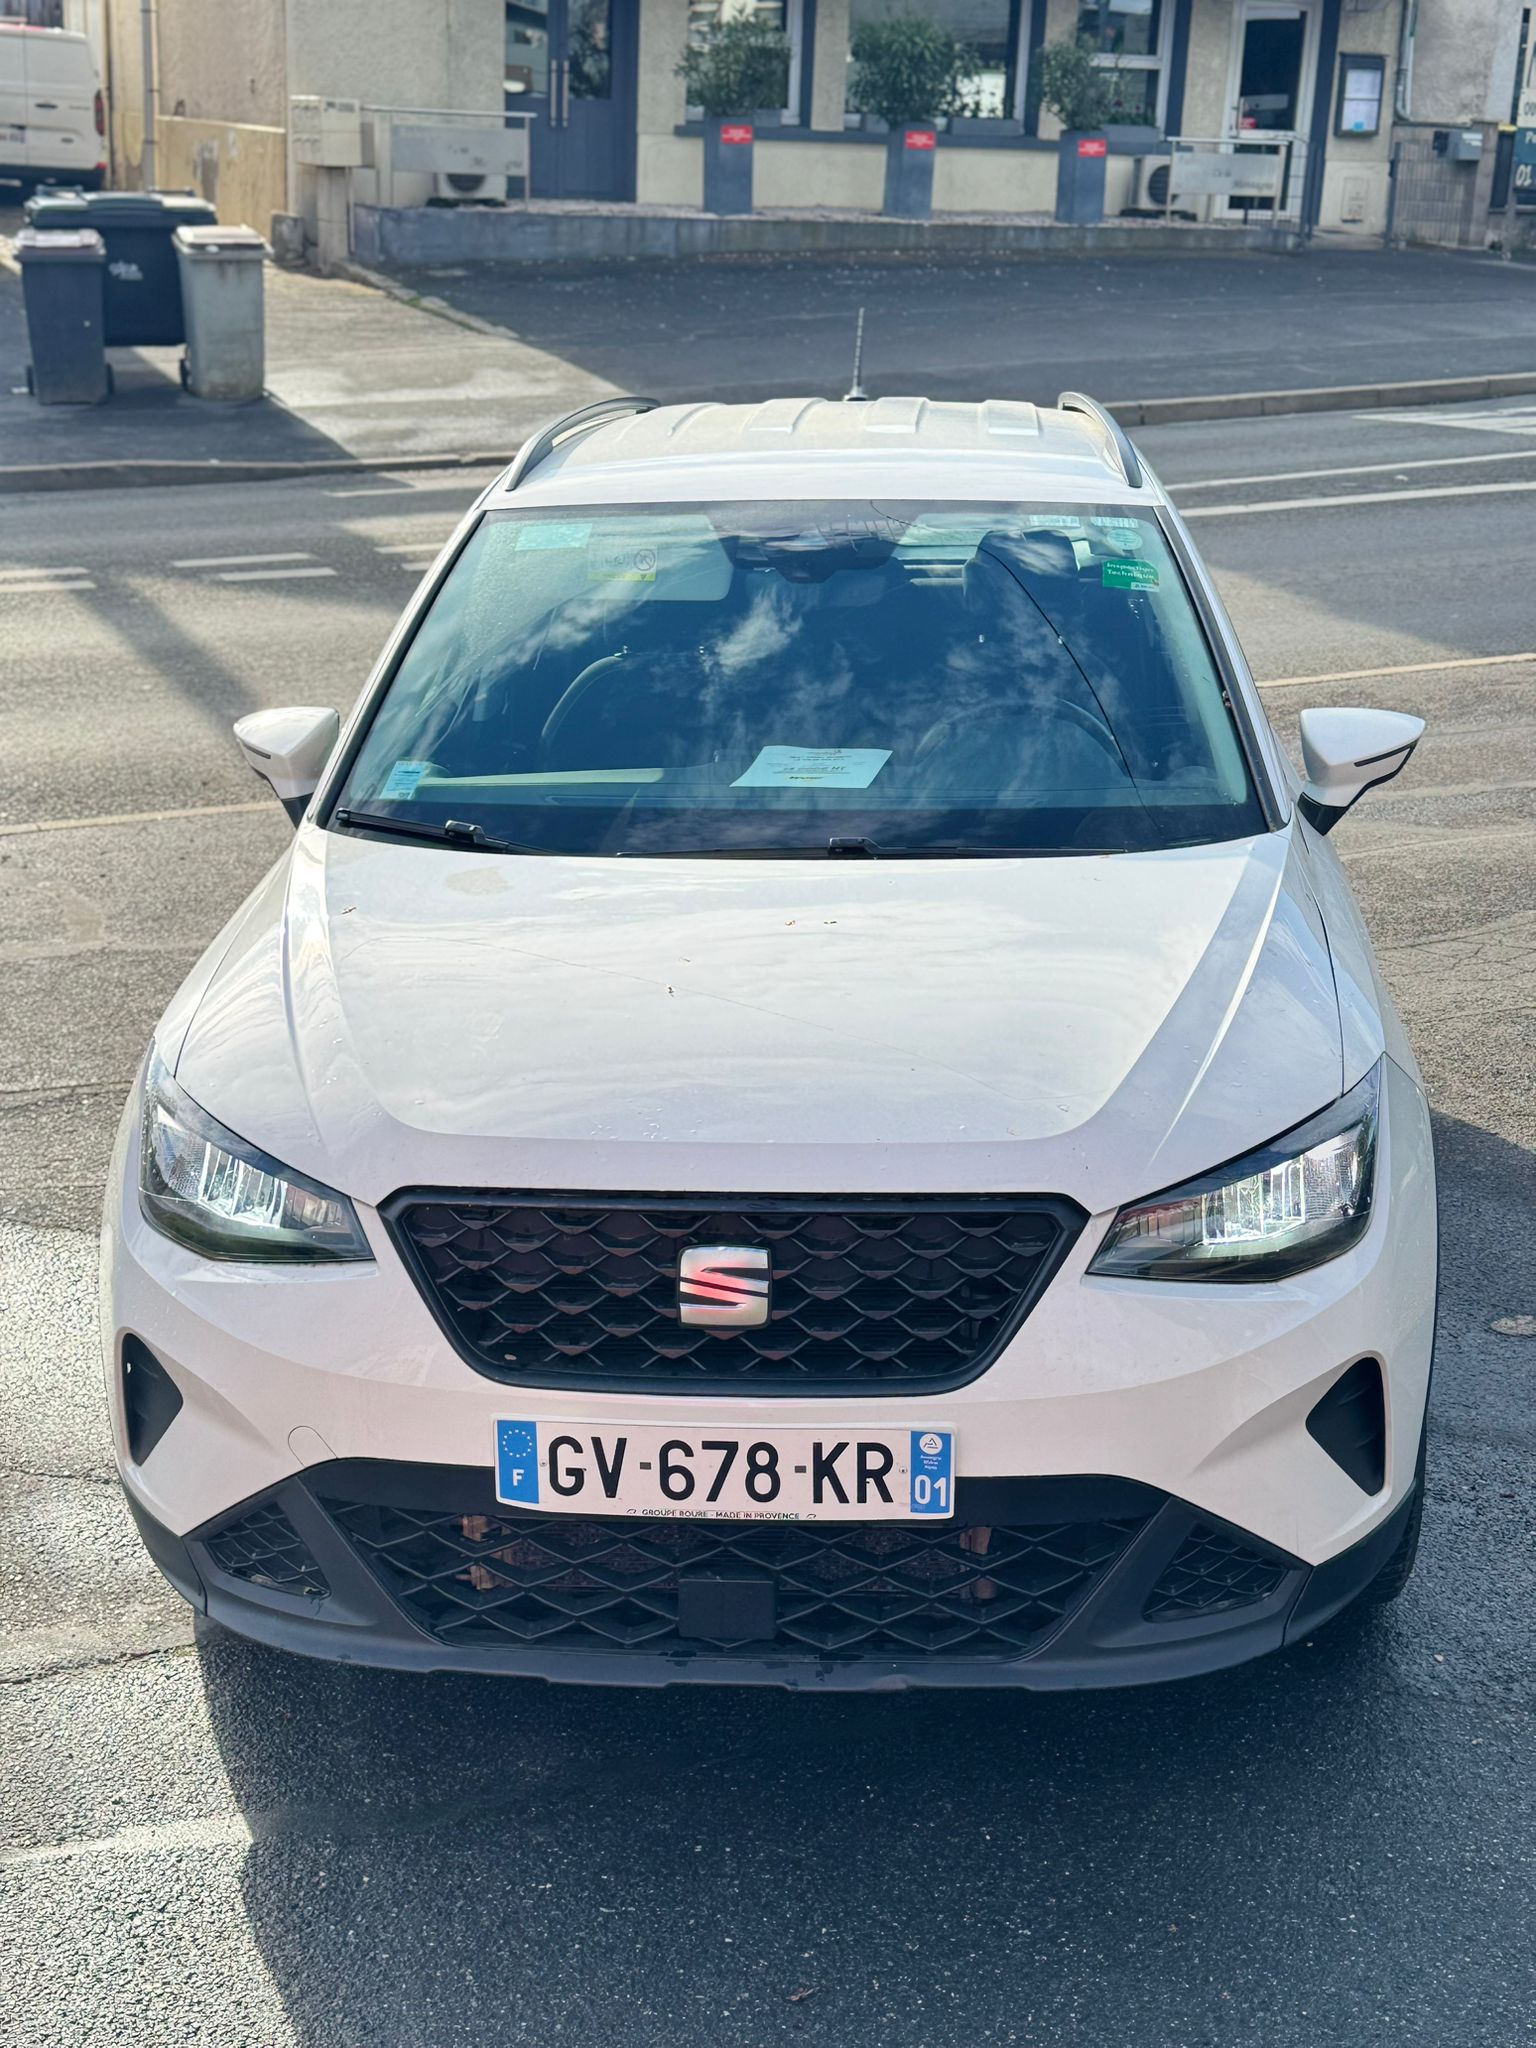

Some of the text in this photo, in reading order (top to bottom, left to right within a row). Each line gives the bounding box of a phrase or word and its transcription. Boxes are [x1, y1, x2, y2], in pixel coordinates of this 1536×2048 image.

[513, 1468, 524, 1487] F
[549, 1435, 894, 1504] GV-678-KR
[915, 1475, 946, 1507] 01
[715, 1511, 741, 1519] MADE
[754, 1512, 800, 1520] PROVENCE
